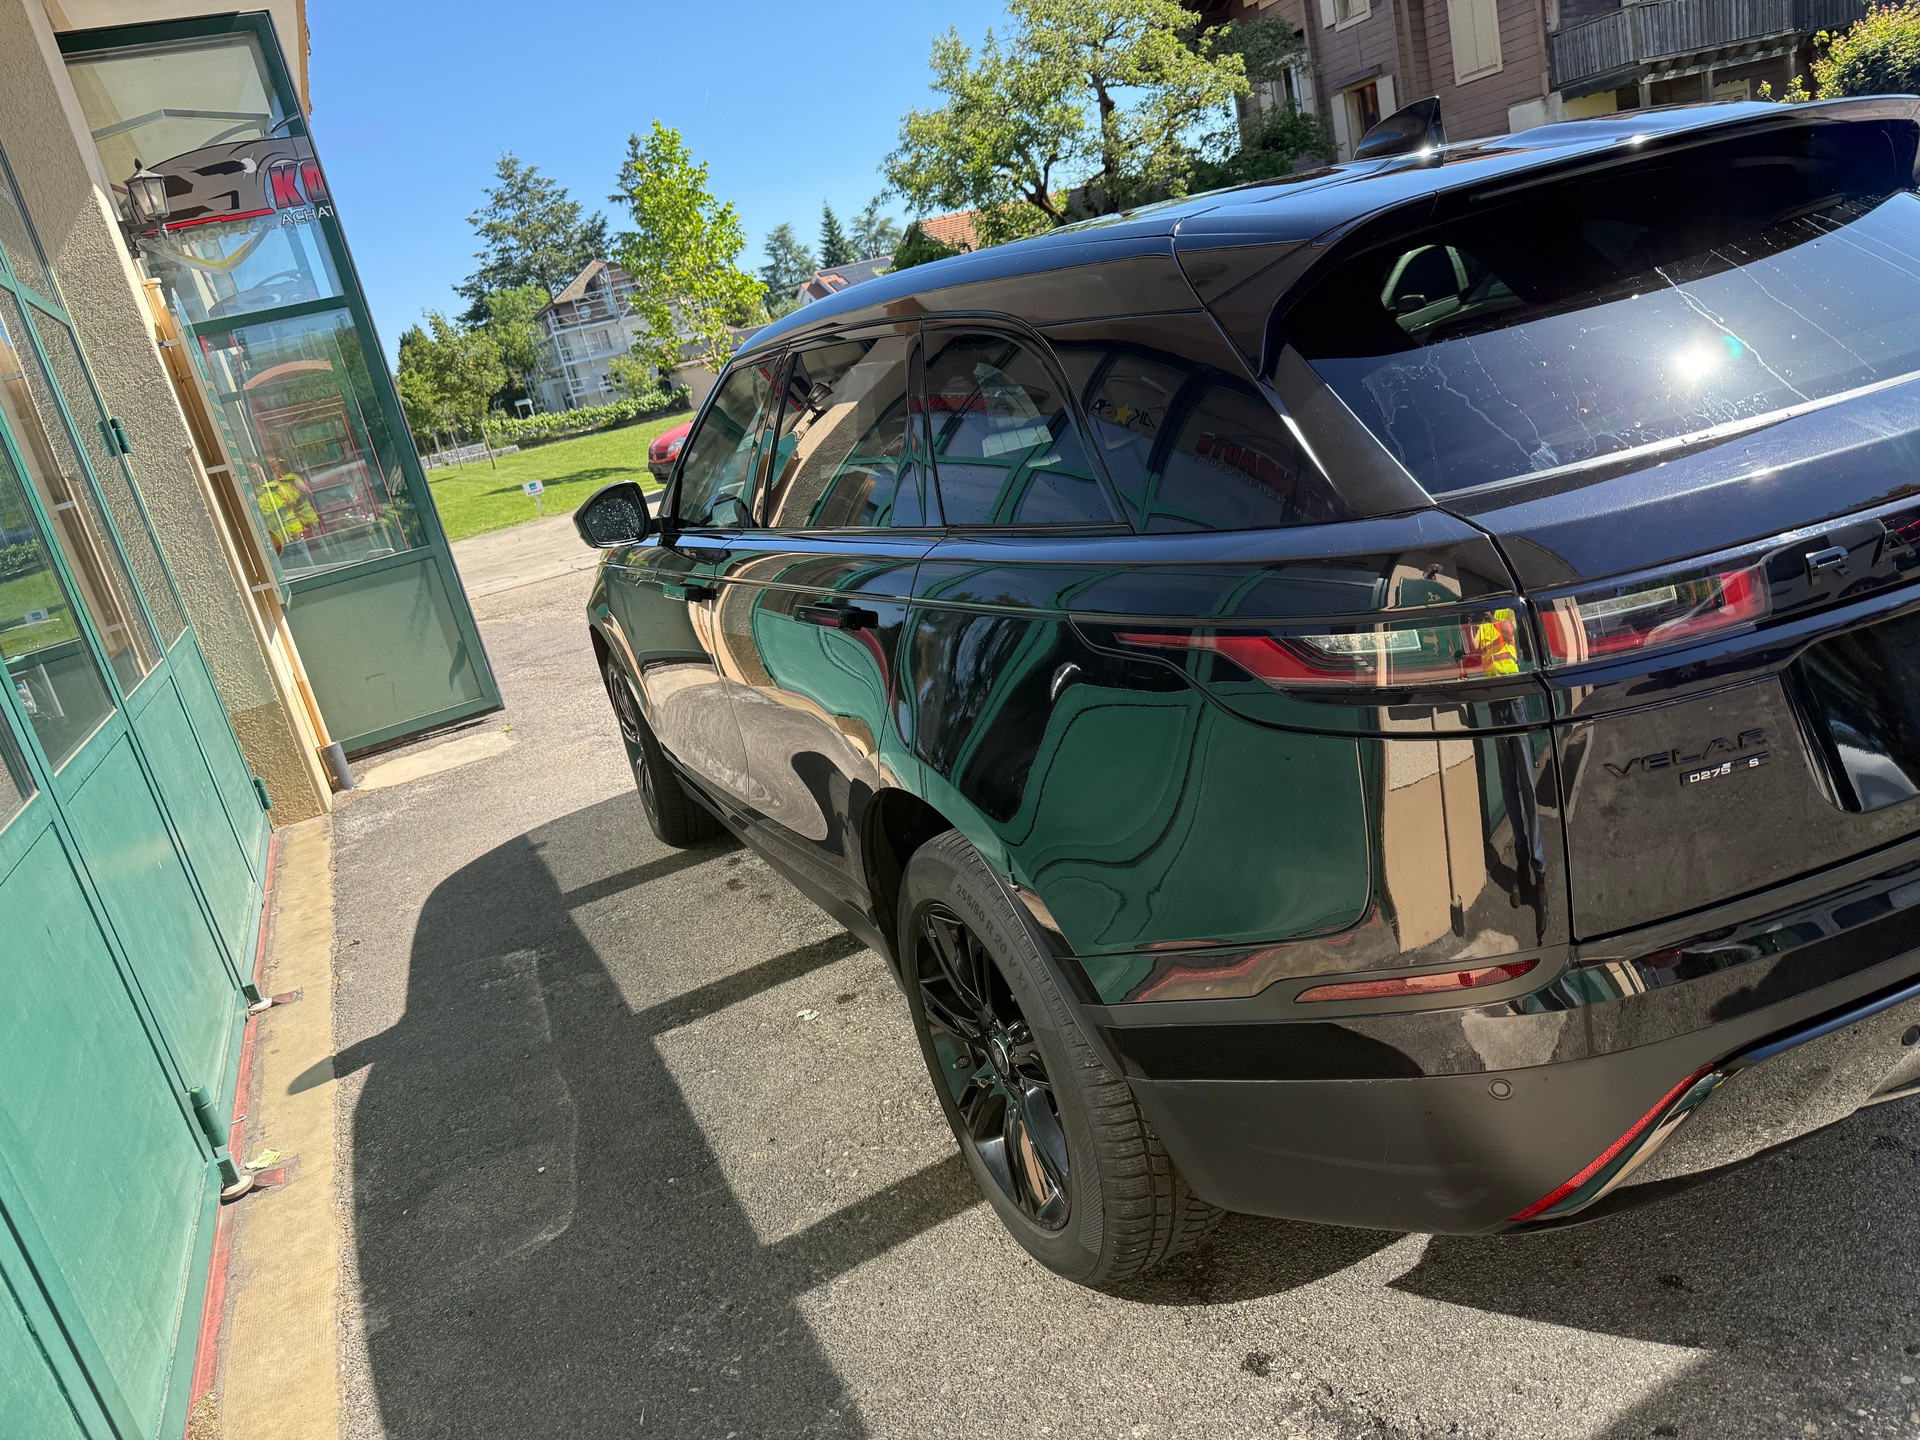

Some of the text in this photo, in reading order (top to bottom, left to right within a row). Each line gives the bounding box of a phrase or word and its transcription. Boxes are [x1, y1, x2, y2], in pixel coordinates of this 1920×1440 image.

[281, 205, 335, 225] ACHAT
[1602, 727, 1766, 778] VELAR
[1689, 757, 1759, 783] D275 S
[955, 884, 986, 923] 255/50
[986, 922, 995, 935] R
[994, 934, 1008, 955] 20
